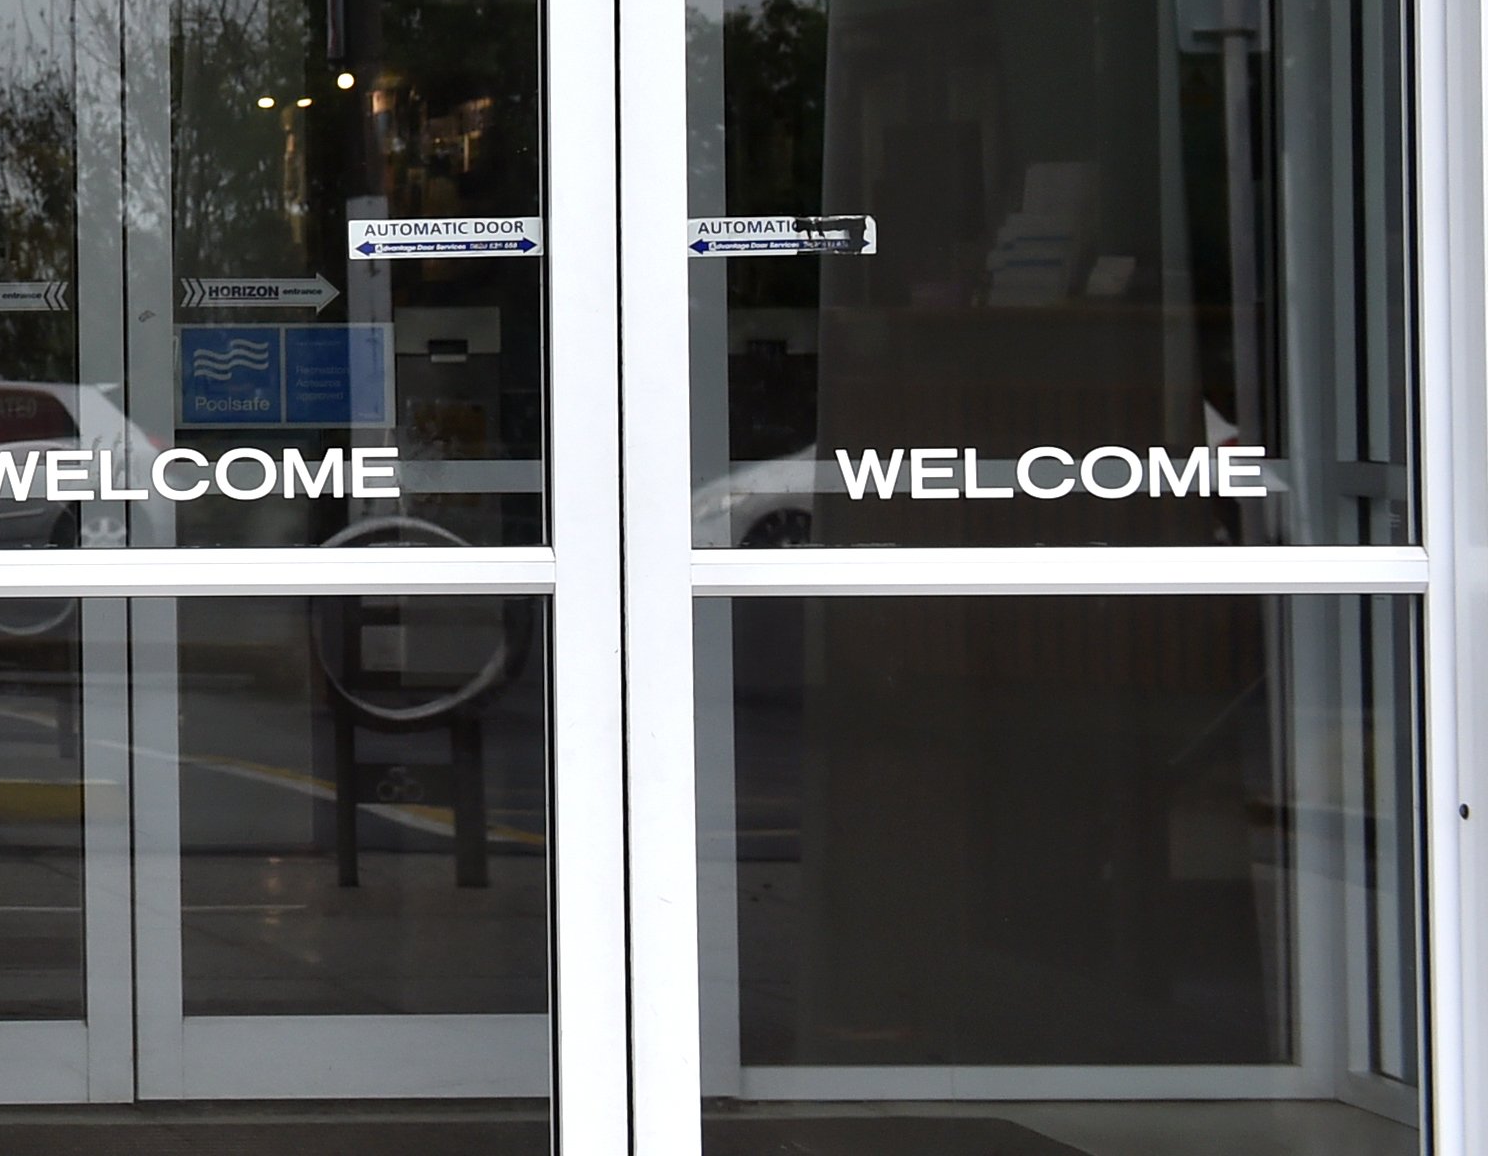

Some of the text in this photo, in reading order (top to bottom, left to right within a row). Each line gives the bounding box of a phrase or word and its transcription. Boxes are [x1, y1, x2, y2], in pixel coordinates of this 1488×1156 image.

[364, 220, 525, 237] AUTOMATIC DOOR
[2, 291, 42, 300] entrance
[208, 286, 323, 298] HORIZON entrance
[194, 396, 271, 412] Poolsafe
[835, 444, 1268, 501] WELCOME
